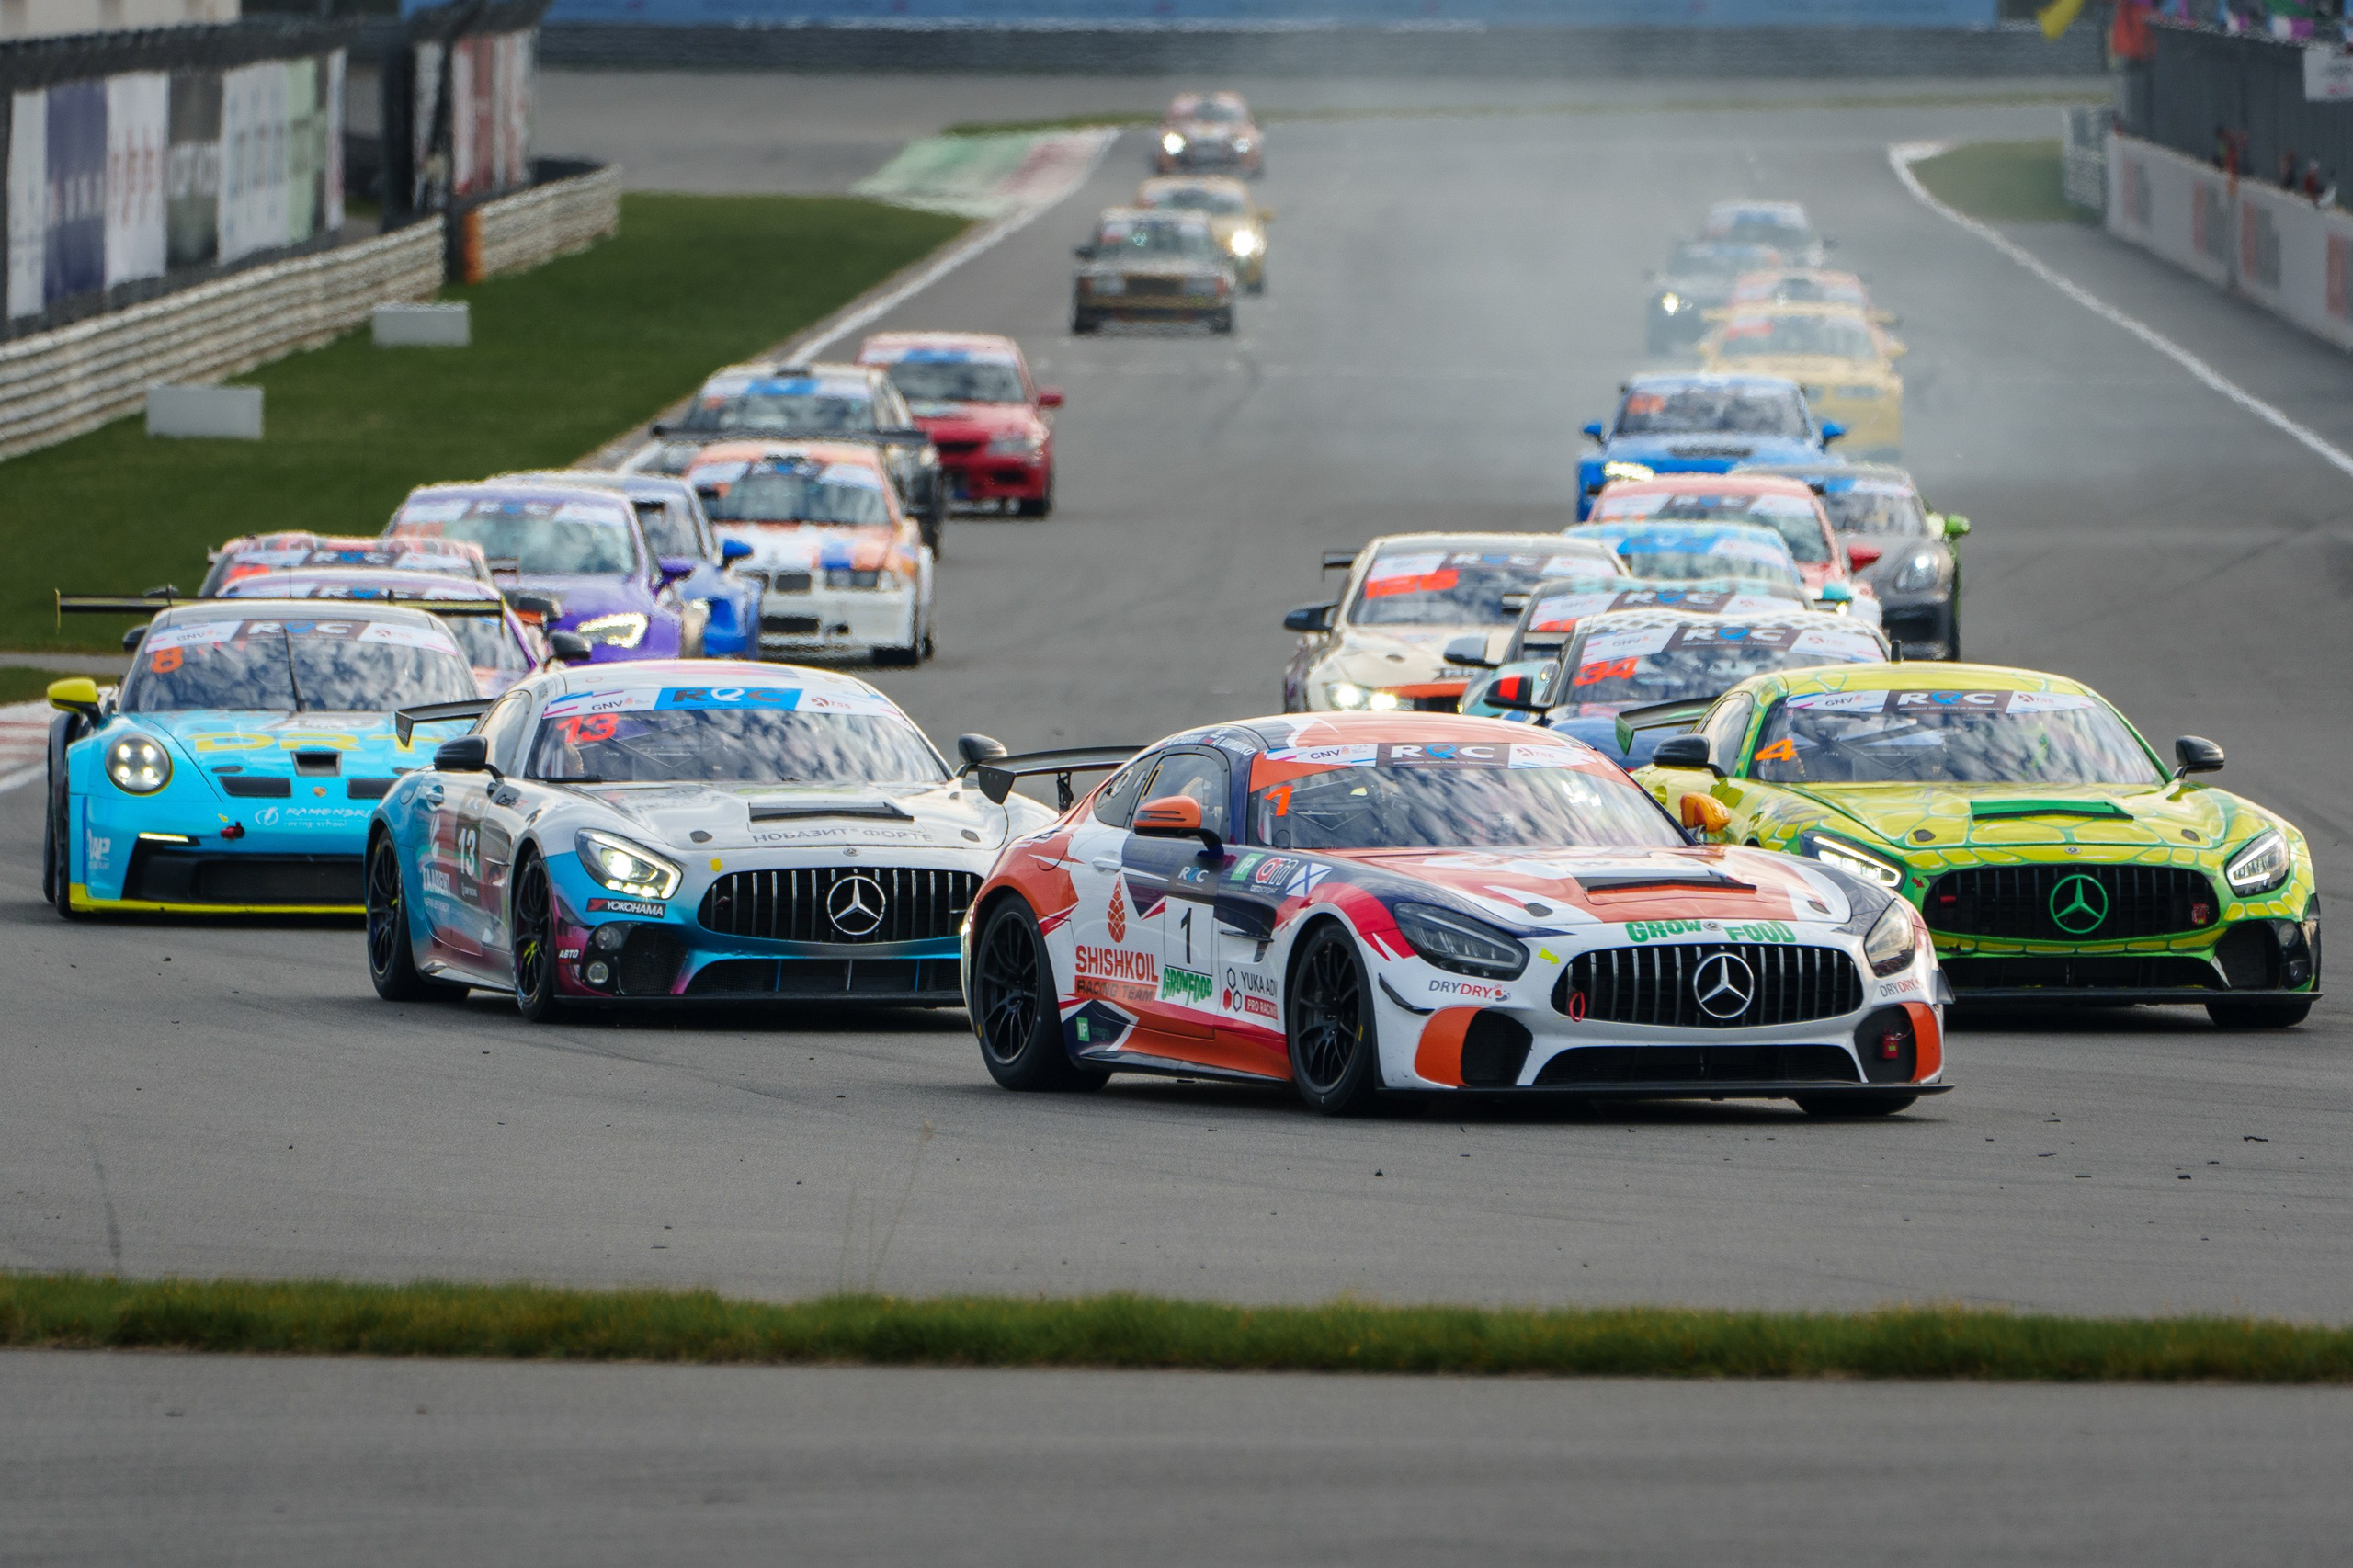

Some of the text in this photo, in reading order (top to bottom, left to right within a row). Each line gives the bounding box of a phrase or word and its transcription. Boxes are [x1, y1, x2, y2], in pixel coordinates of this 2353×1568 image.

[151, 646, 184, 674] 8
[1574, 656, 1640, 687] 34
[591, 700, 624, 711] GNV
[1825, 697, 1854, 708] GNV
[556, 712, 620, 744] 13
[1310, 749, 1341, 760] GNV
[1755, 739, 1797, 762] 4
[1264, 785, 1294, 817] 1
[863, 829, 935, 843] ФОРТЕ
[458, 827, 477, 876] 13
[607, 901, 664, 916] YOKOHAMA
[1180, 907, 1192, 965] 1
[1625, 920, 1797, 944] GROW FOOD
[1074, 945, 1159, 983] SHISHKOIL
[1076, 979, 1154, 1003] RACING TEAM
[1162, 967, 1213, 1006] GROWFOOD
[1241, 971, 1265, 994] YUKA
